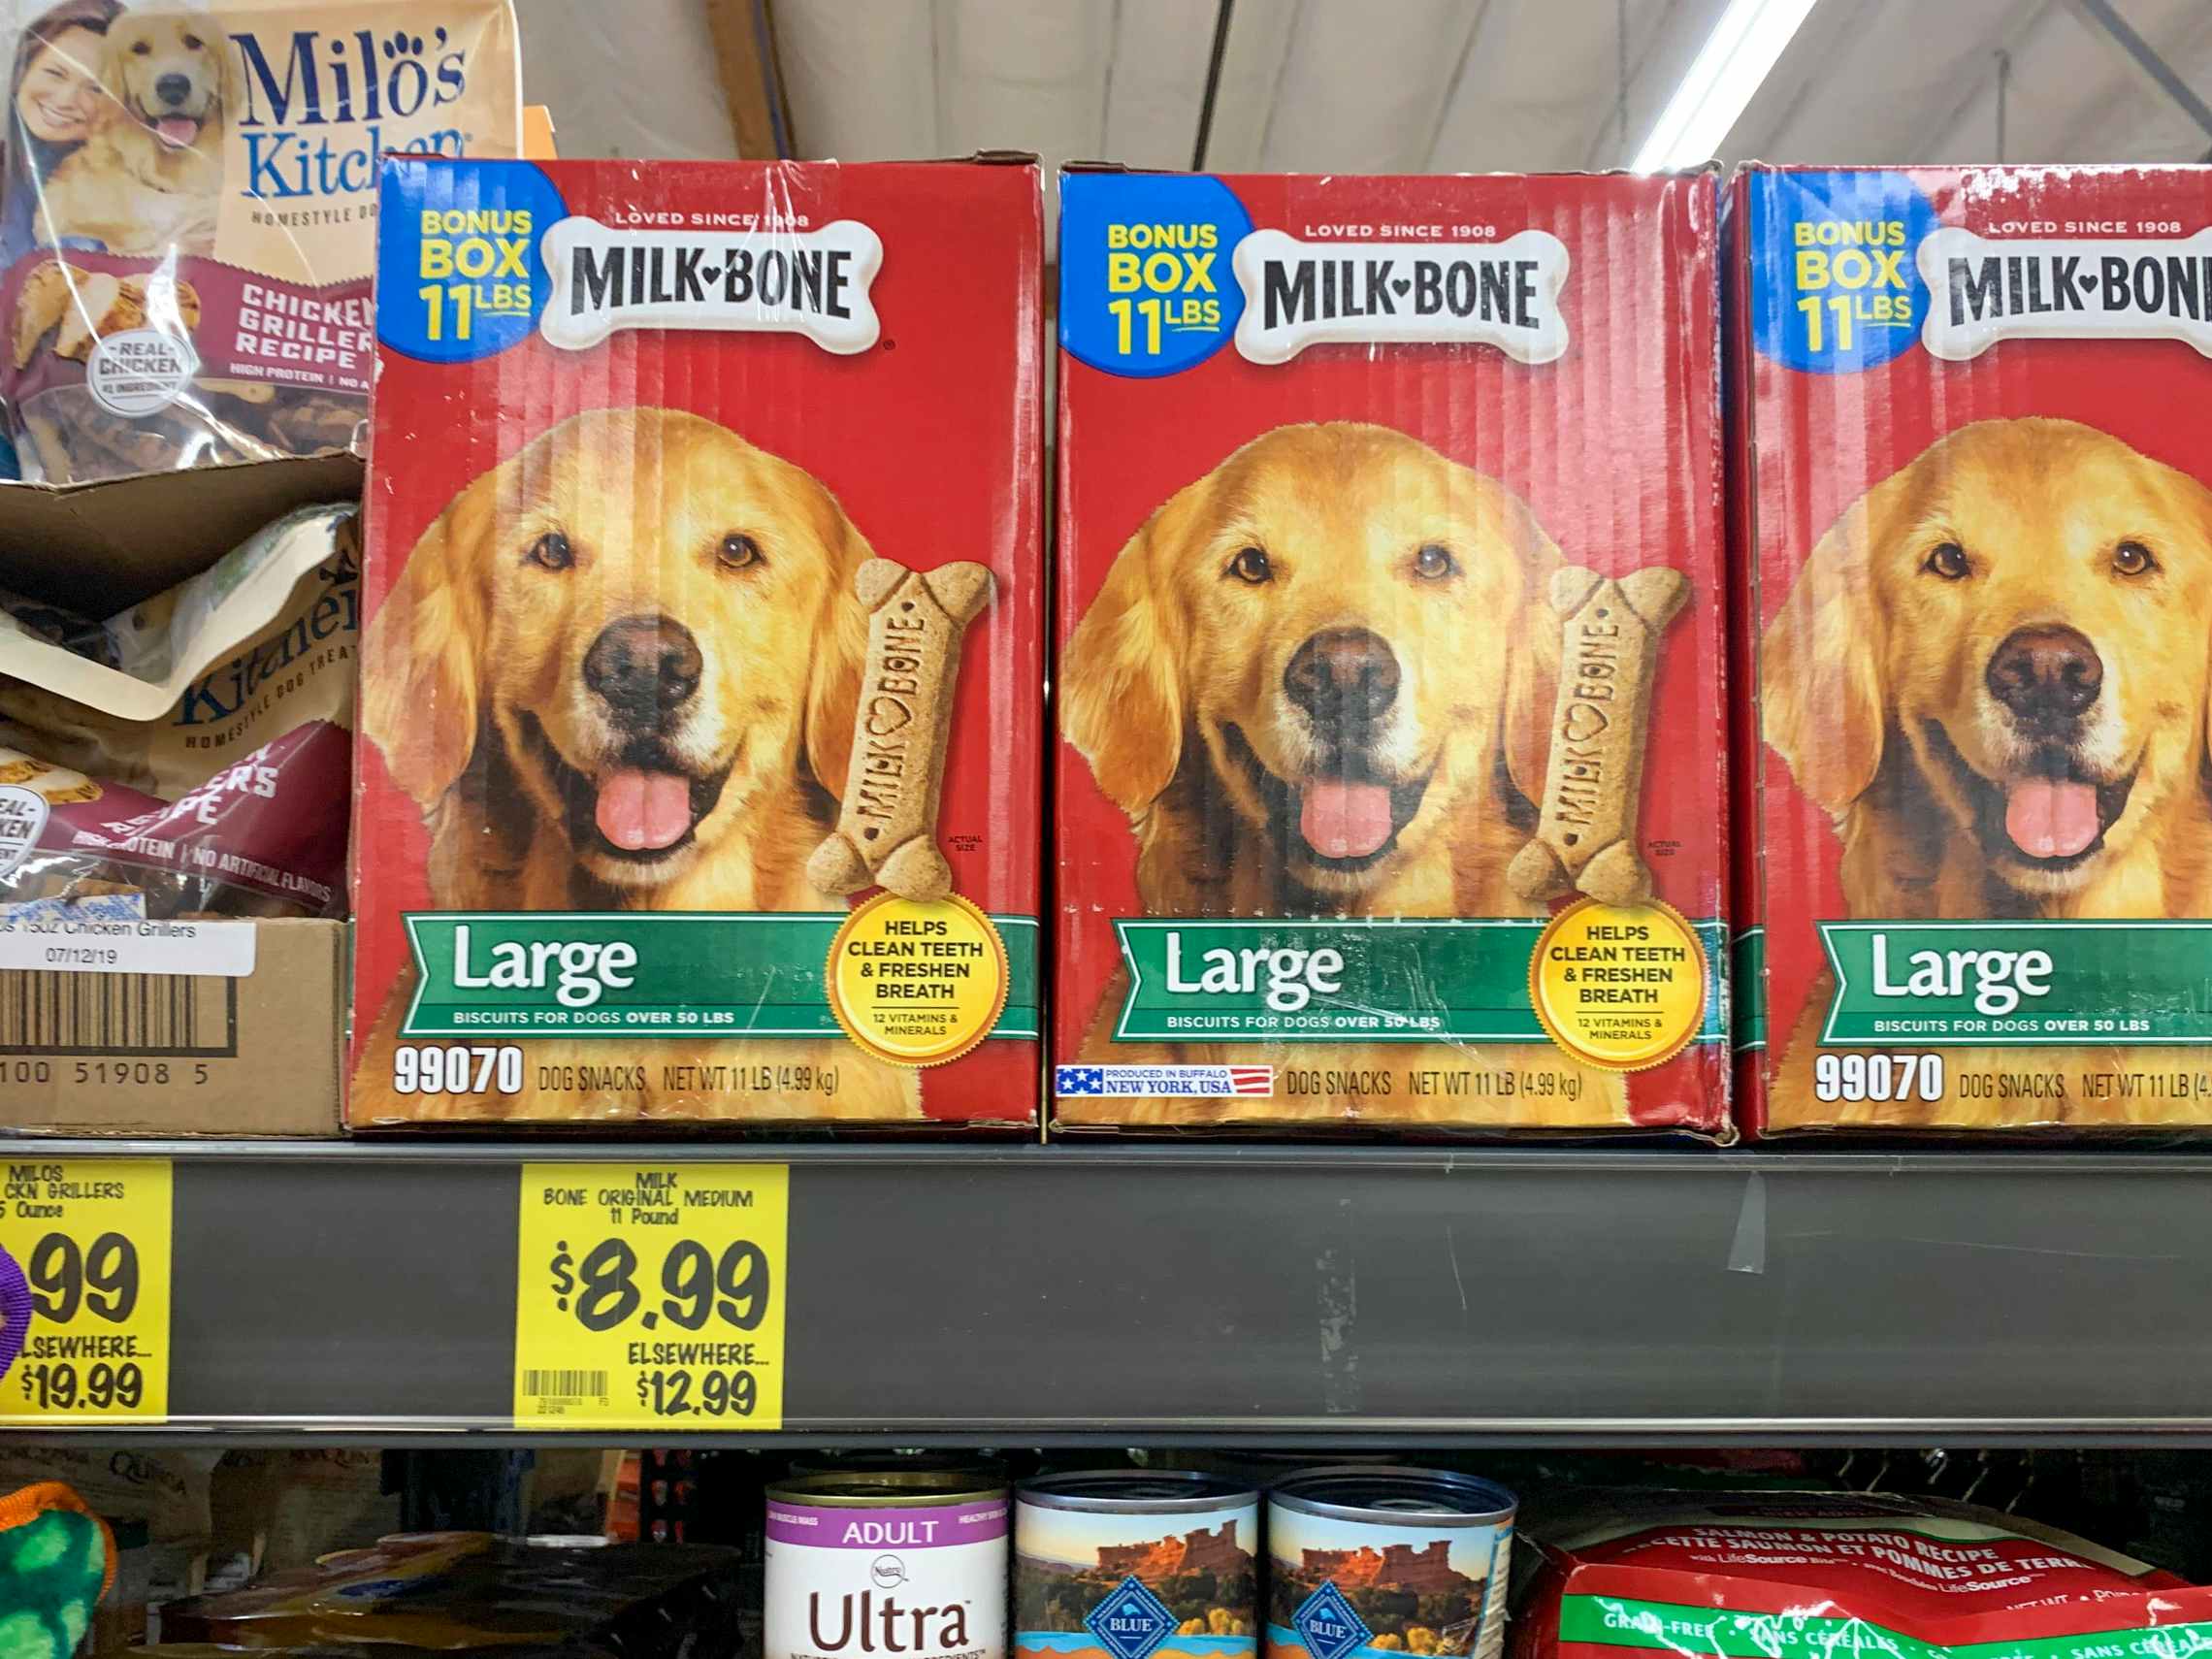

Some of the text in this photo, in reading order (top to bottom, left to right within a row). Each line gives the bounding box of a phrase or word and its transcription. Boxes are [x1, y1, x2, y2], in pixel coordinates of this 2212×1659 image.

[228, 26, 467, 127] Milo's
[251, 206, 350, 228] HOMESTYLE
[421, 210, 533, 235] BONUS
[615, 211, 684, 226] LOVED
[691, 212, 757, 226] SINCE
[1988, 221, 2182, 234] LOVED SINCE 1908
[1108, 224, 1218, 249] BONUS
[1305, 224, 1496, 239] LOVED SINCE 1908
[1795, 222, 1906, 247] BONUS
[419, 239, 532, 278] BOX
[1108, 253, 1217, 293] BOX
[1796, 250, 1906, 291] BOX
[419, 284, 532, 341] 11 LBS
[1797, 295, 1911, 351] 11 LBS
[1108, 298, 1220, 355] 11 LBS
[234, 332, 357, 370] RECIPE
[884, 920, 948, 937] HELPS
[1586, 926, 1649, 941] HELPS
[46, 947, 117, 964] 07/12/19
[848, 941, 984, 958] CLEAN TEETH
[1550, 946, 1685, 961] CLEAN TEETH
[453, 924, 637, 1008] Large
[861, 962, 970, 978] & FRESHEN
[1166, 931, 1345, 1012] Large
[1564, 968, 1674, 983] & FRESHEN
[1871, 933, 2054, 1016] Large
[875, 983, 956, 999] BREATH
[1579, 988, 1658, 1004] BREATH
[453, 1011, 735, 1025] BISCUITS FOR DOGS OVER 50 LBS
[873, 1014, 958, 1024] 12 VITAMINS &
[1167, 1015, 1441, 1029] BISCUITS FOR DOGS OVER 50 LBS
[1578, 1019, 1663, 1028] 12 VITAMINS &
[1873, 1020, 2150, 1032] BISCUITS FOR DOGS OVER 50 LBS
[884, 1025, 947, 1035] MINERALS
[1589, 1030, 1652, 1040] MINERALS
[74, 1063, 209, 1086] 51908 5
[393, 1045, 524, 1094] 99070
[538, 1065, 646, 1091] DOG SNACKS
[1105, 1069, 1228, 1079] PRODUCED IN BUFFALO
[1815, 1053, 1944, 1102] 99070
[663, 1066, 839, 1096] NET WT 11 LB (4.99 kg)
[1106, 1079, 1149, 1094] NEW
[1200, 1079, 1233, 1094] USA
[1286, 1070, 1391, 1095] DOG SNACKS
[1409, 1071, 1582, 1101] NET WT 11 LB (4.99 kg)
[1959, 1073, 2065, 1098] DOG SNACKS
[2082, 1073, 2190, 1098] NET WT 11 LB
[9, 1165, 63, 1184] MILOS
[635, 1172, 677, 1189] MILK
[5, 1183, 125, 1200] CKN GRILLERS
[543, 1188, 754, 1208] BONE ORIGINAL MEDIUM
[16, 1201, 64, 1219] Ounce
[632, 1208, 680, 1225] Pound
[550, 1237, 769, 1332] $8.99
[20, 1362, 144, 1410] $19.99
[636, 1369, 757, 1416] $12.99
[841, 1520, 939, 1545] ADULT
[1692, 1527, 1796, 1543] SALMON
[1821, 1532, 1910, 1550] POTATO
[1916, 1541, 2000, 1563] RECIPE
[1728, 1538, 1833, 1554] SAUMON
[1838, 1544, 1866, 1556] ET
[1872, 1545, 1972, 1580] POMMES
[1976, 1561, 2014, 1575] DE
[809, 1589, 970, 1653] Ultra
[1109, 1617, 1153, 1632] BLUE
[1310, 1620, 1346, 1639] BLUE
